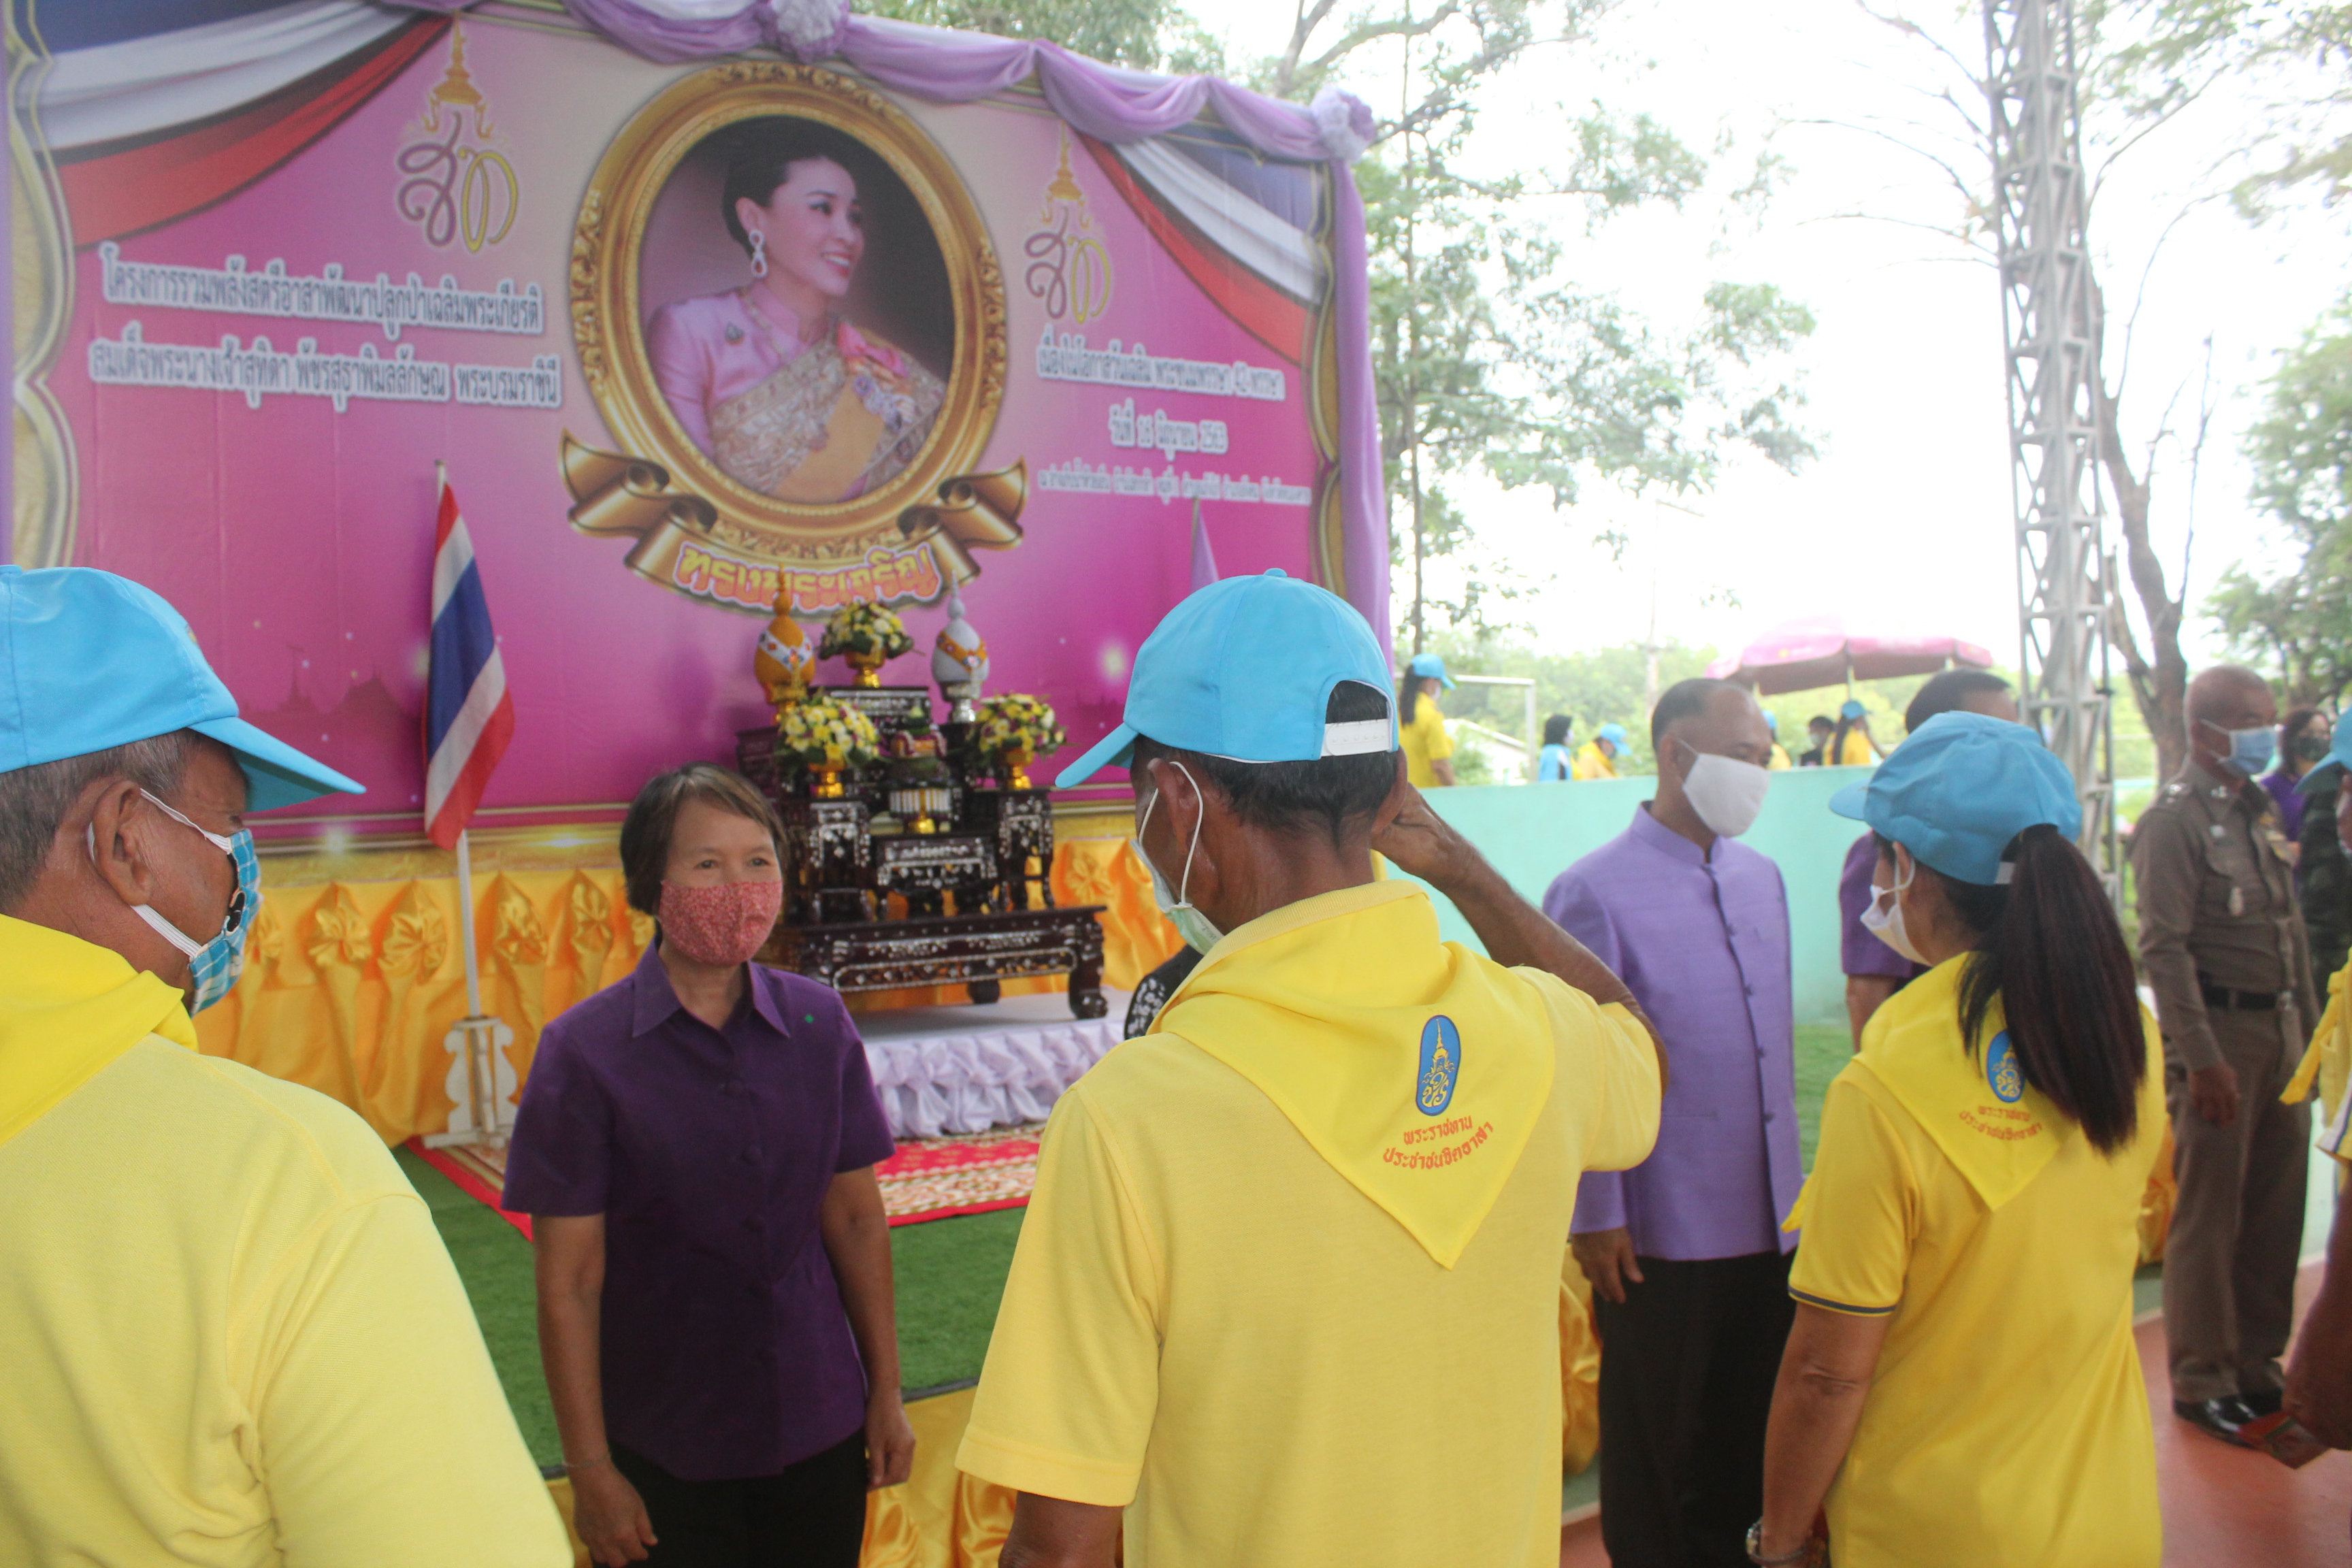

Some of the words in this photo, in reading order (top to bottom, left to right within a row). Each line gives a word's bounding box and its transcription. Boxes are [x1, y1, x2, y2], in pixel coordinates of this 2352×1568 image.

[91, 322, 291, 408] สมเด็จพระนางเจ้าสุทิดา
[457, 357, 560, 405] พระบรมราชินี
[675, 543, 942, 610] ทรงพระเจริญ
[1383, 1122, 1494, 1169] ประชาชนจิตอาสา
[1403, 1115, 1473, 1145] พระราชทาน
